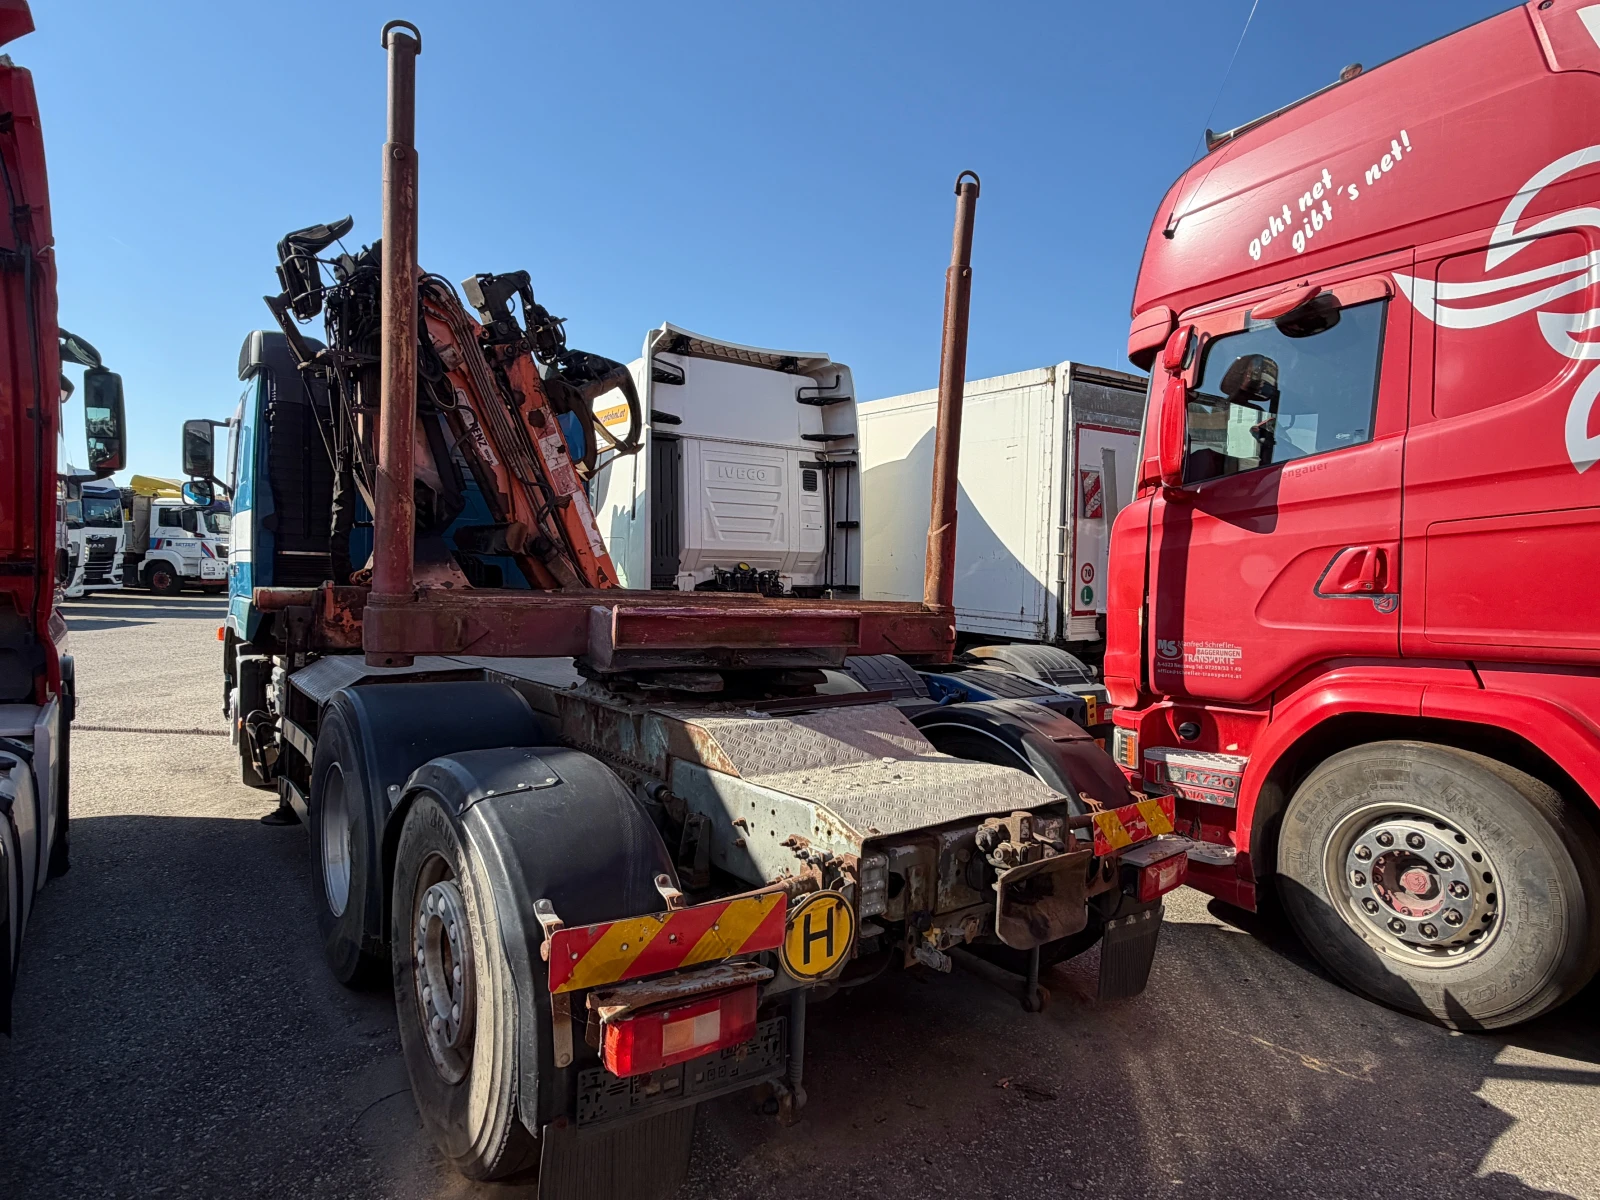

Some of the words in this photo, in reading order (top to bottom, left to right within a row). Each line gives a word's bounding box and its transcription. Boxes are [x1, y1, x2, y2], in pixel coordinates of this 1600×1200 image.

[1365, 129, 1412, 186] net!
[1249, 204, 1291, 260] geht
[1298, 168, 1332, 211] net
[718, 466, 766, 481] IVECO
[1084, 568, 1092, 577] 70
[1084, 589, 1090, 601] L
[1157, 639, 1177, 656] MS
[1197, 649, 1241, 657] BAGGERUNGEN
[1184, 653, 1235, 665] TRANSPORTE
[1185, 771, 1198, 783] R
[1200, 773, 1236, 788] 730
[803, 907, 834, 965] H
